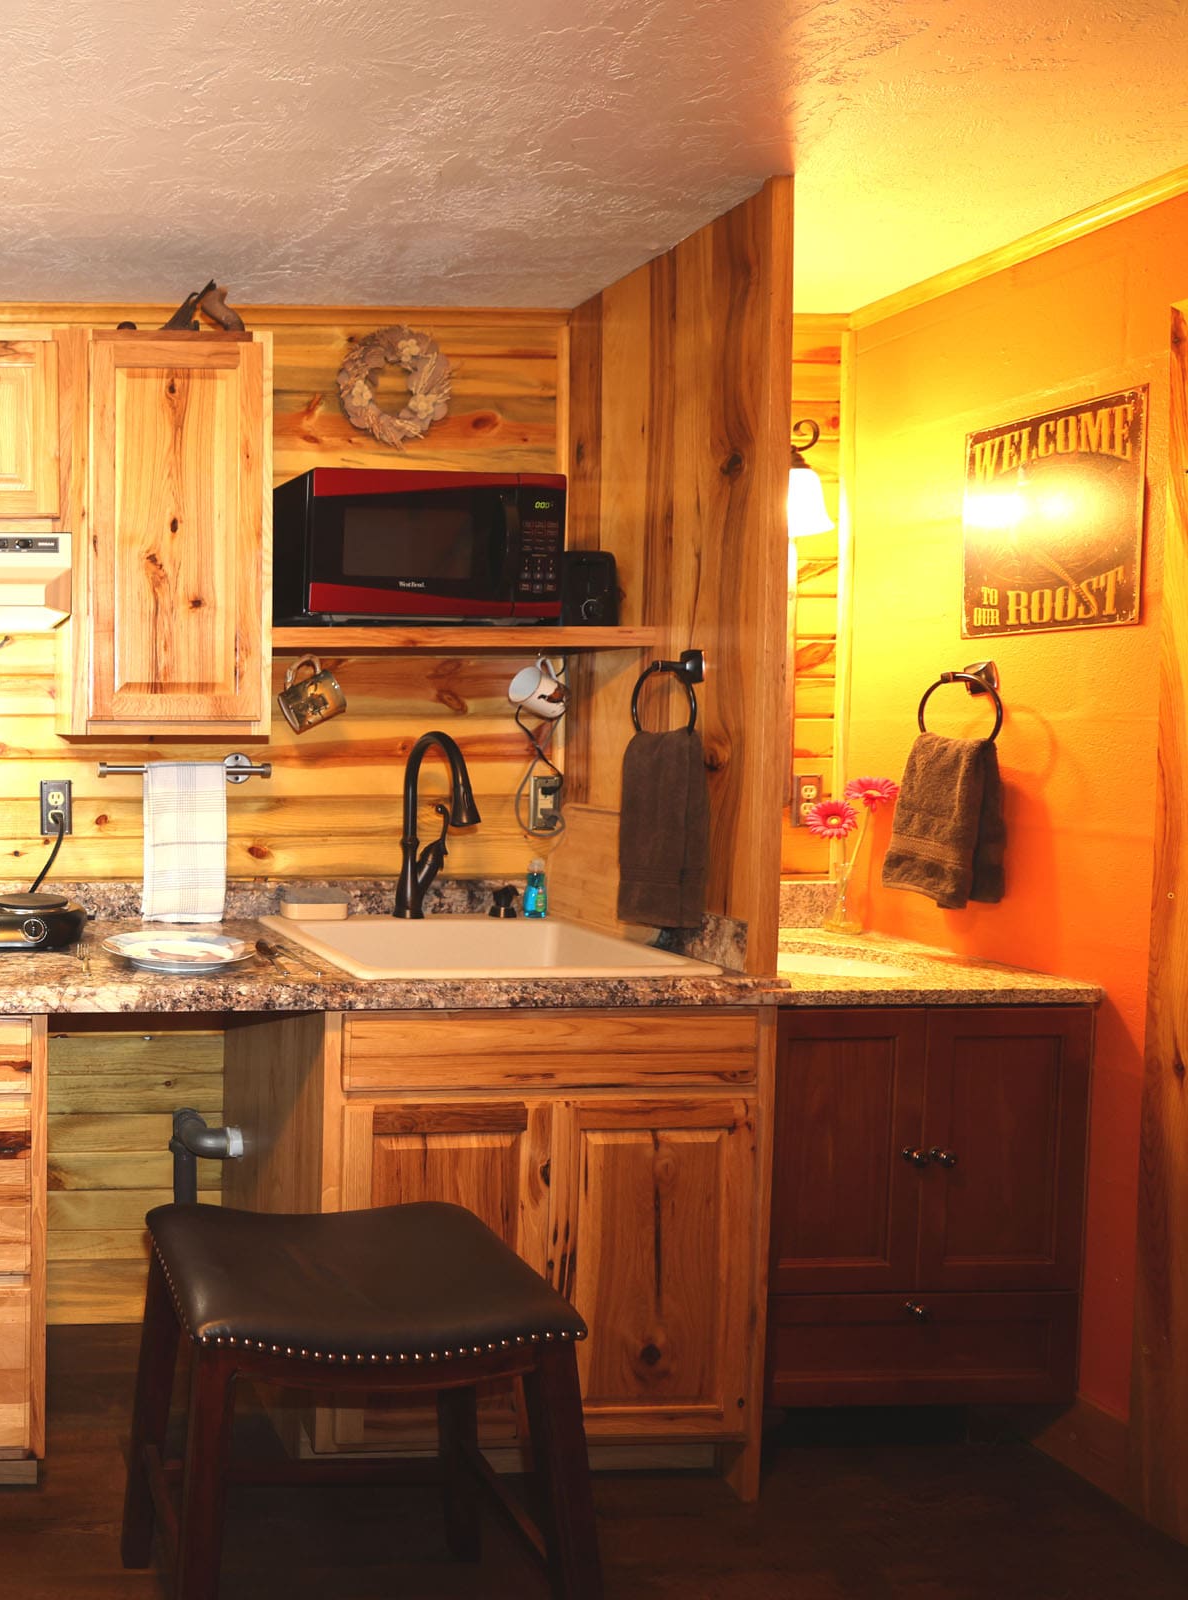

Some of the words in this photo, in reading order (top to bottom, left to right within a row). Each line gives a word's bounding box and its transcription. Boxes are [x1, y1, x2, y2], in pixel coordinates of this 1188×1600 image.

[973, 403, 1134, 482] WELCOME
[981, 586, 999, 606] TO
[1006, 565, 1126, 626] ROOST
[973, 607, 1000, 627] OUR
